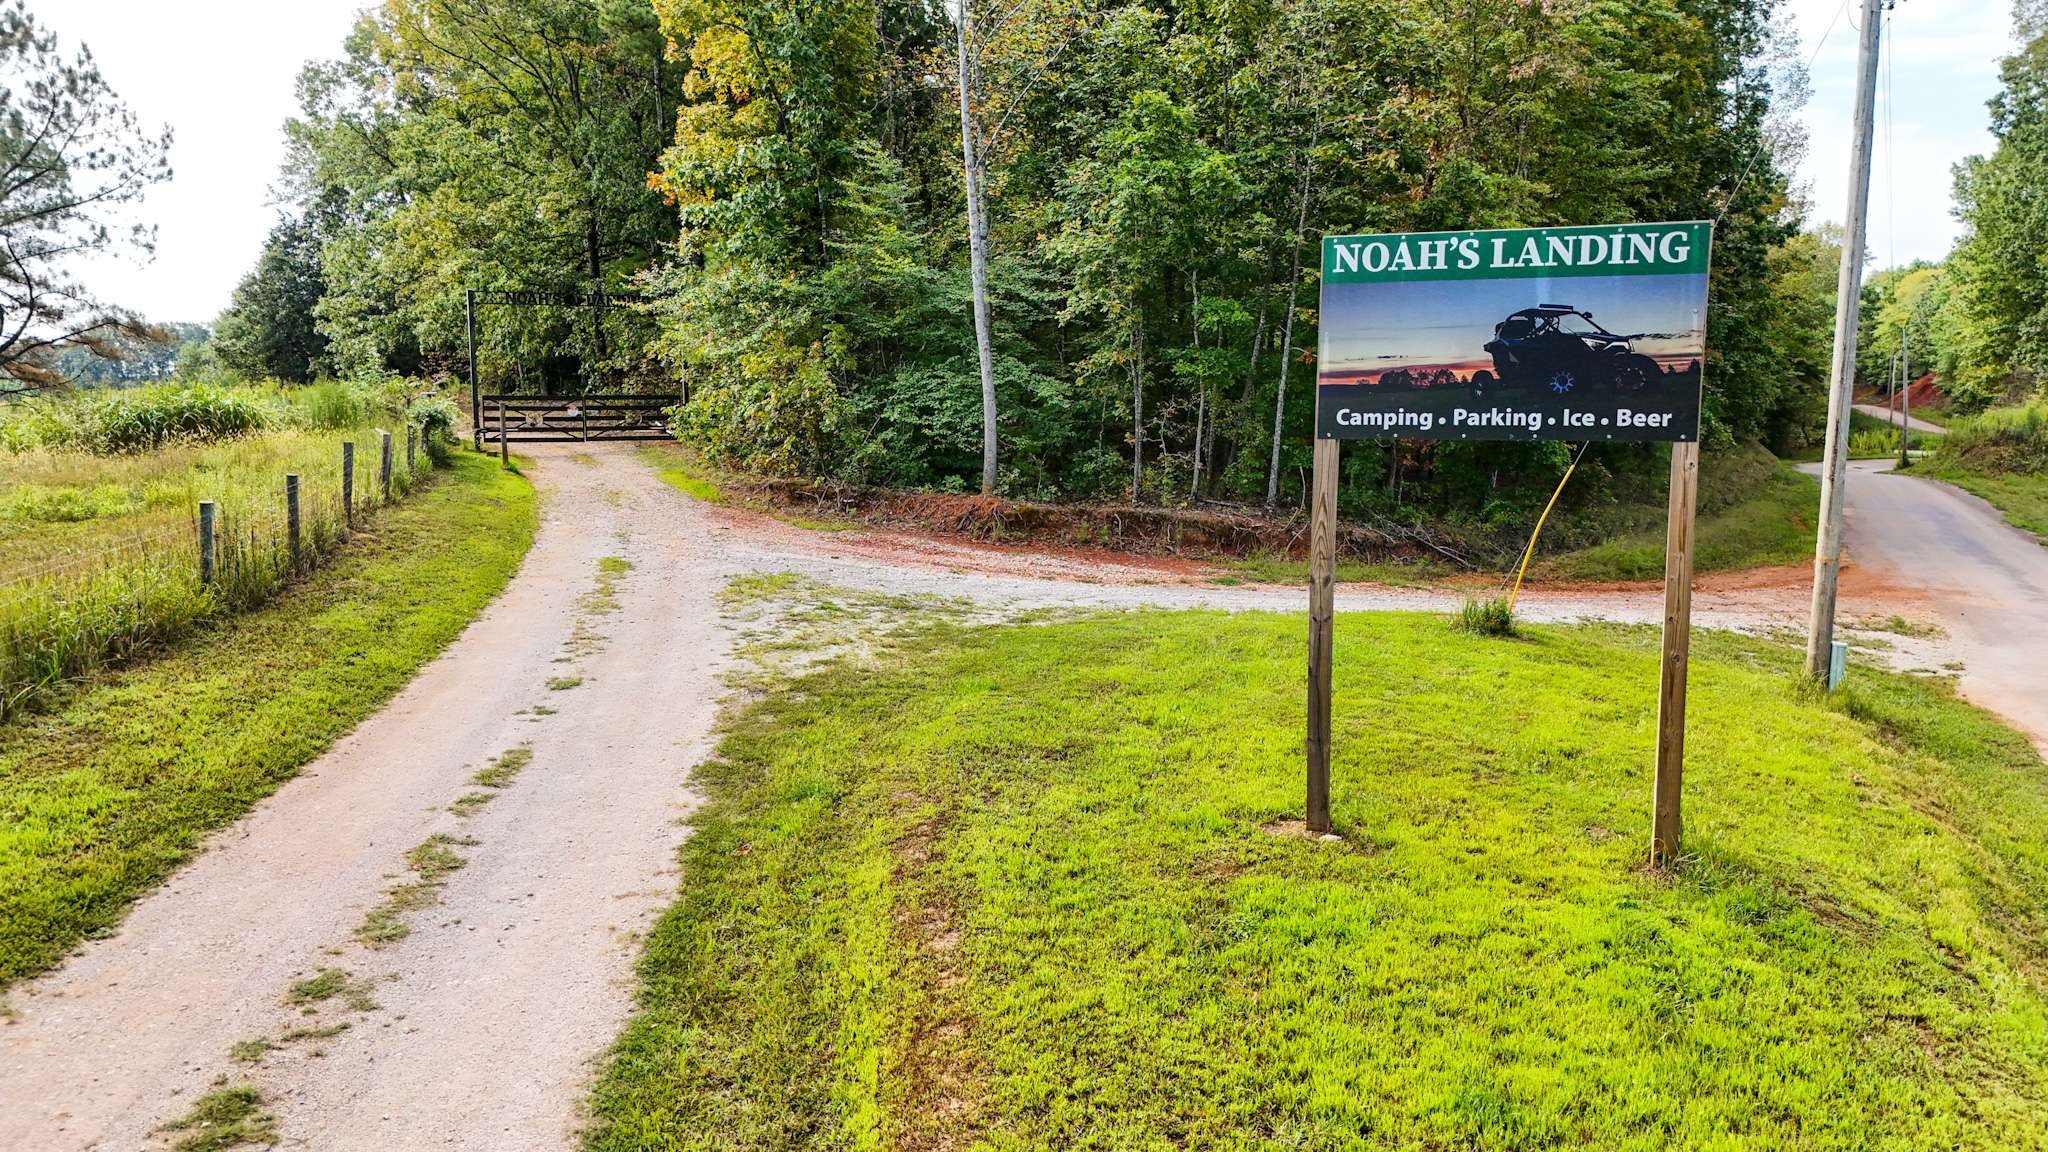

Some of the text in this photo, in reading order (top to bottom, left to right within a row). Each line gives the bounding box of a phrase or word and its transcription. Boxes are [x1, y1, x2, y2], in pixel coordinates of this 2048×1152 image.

[1332, 231, 1691, 273] NOAH'S LANDING
[1335, 408, 1673, 431] Camping Parking Ice Beer
